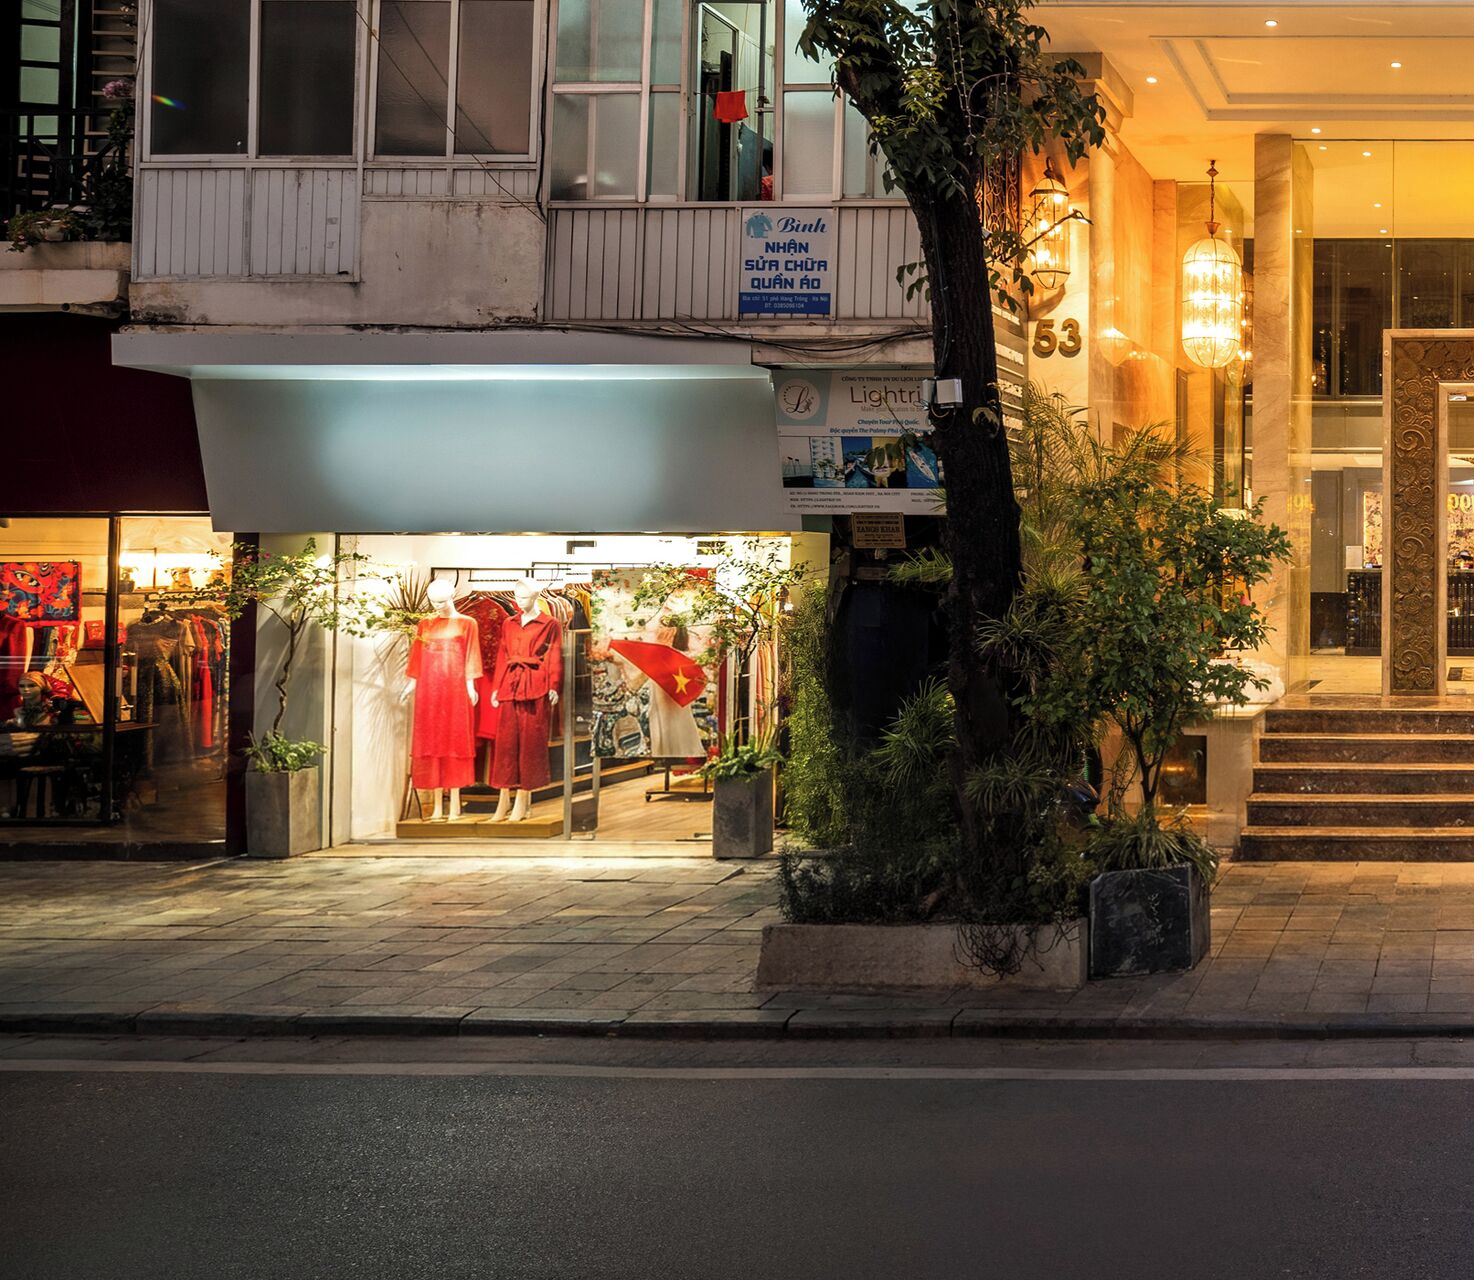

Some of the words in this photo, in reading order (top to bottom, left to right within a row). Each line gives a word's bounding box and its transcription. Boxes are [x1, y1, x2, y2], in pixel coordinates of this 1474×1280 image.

[776, 216, 827, 233] Bình
[765, 238, 809, 256] NHẬN
[744, 255, 779, 271] SỬA
[784, 257, 827, 271] CHỮA
[751, 272, 794, 290] QUẦN
[800, 274, 821, 289] ÁO
[1034, 318, 1082, 355] 53
[850, 385, 921, 407] Lightri
